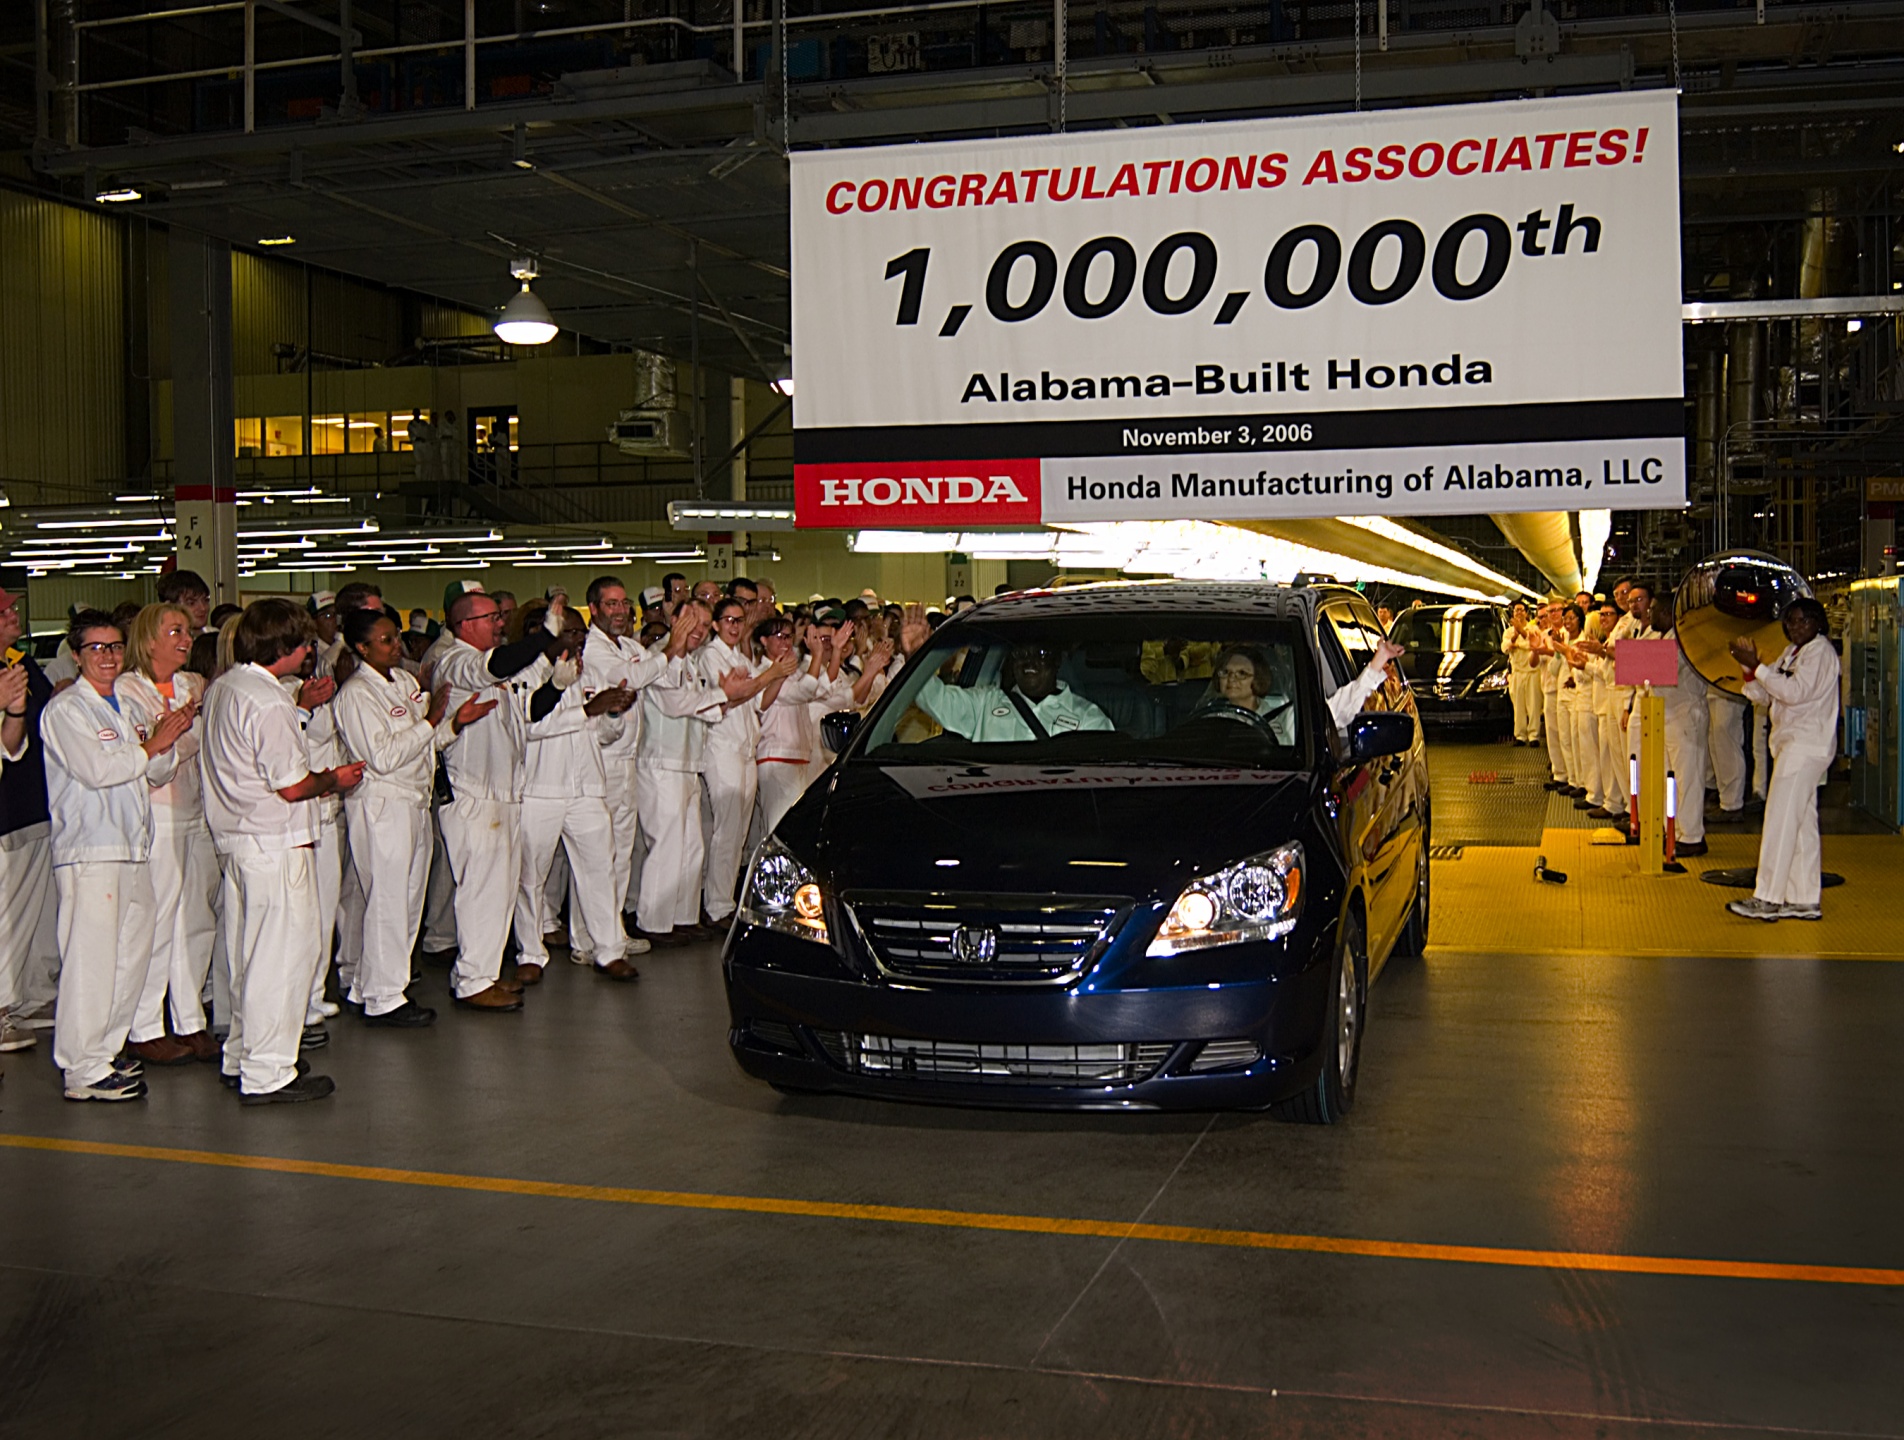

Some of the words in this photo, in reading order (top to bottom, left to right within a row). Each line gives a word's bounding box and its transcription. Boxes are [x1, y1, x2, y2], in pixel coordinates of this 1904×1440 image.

[826, 153, 1288, 215] CONGRATULATIONS
[1302, 128, 1649, 186] ASSOCIATES!
[884, 204, 1602, 337] 1,000,000th
[961, 361, 1310, 404] Alabama-Built
[1327, 353, 1492, 390] Honda
[1122, 426, 1232, 447] November
[1238, 425, 1256, 446] 3,
[1262, 423, 1313, 443] 2006
[819, 475, 1029, 506] HONDA
[1067, 474, 1161, 501] Honda
[1171, 468, 1393, 499] Manufacturing
[1403, 465, 1434, 492] of
[1443, 463, 1593, 491] Alabama,
[1603, 457, 1663, 486] LLC
[190, 516, 199, 531] F
[184, 535, 203, 550] 24
[718, 548, 724, 557] F
[713, 559, 727, 569] 23
